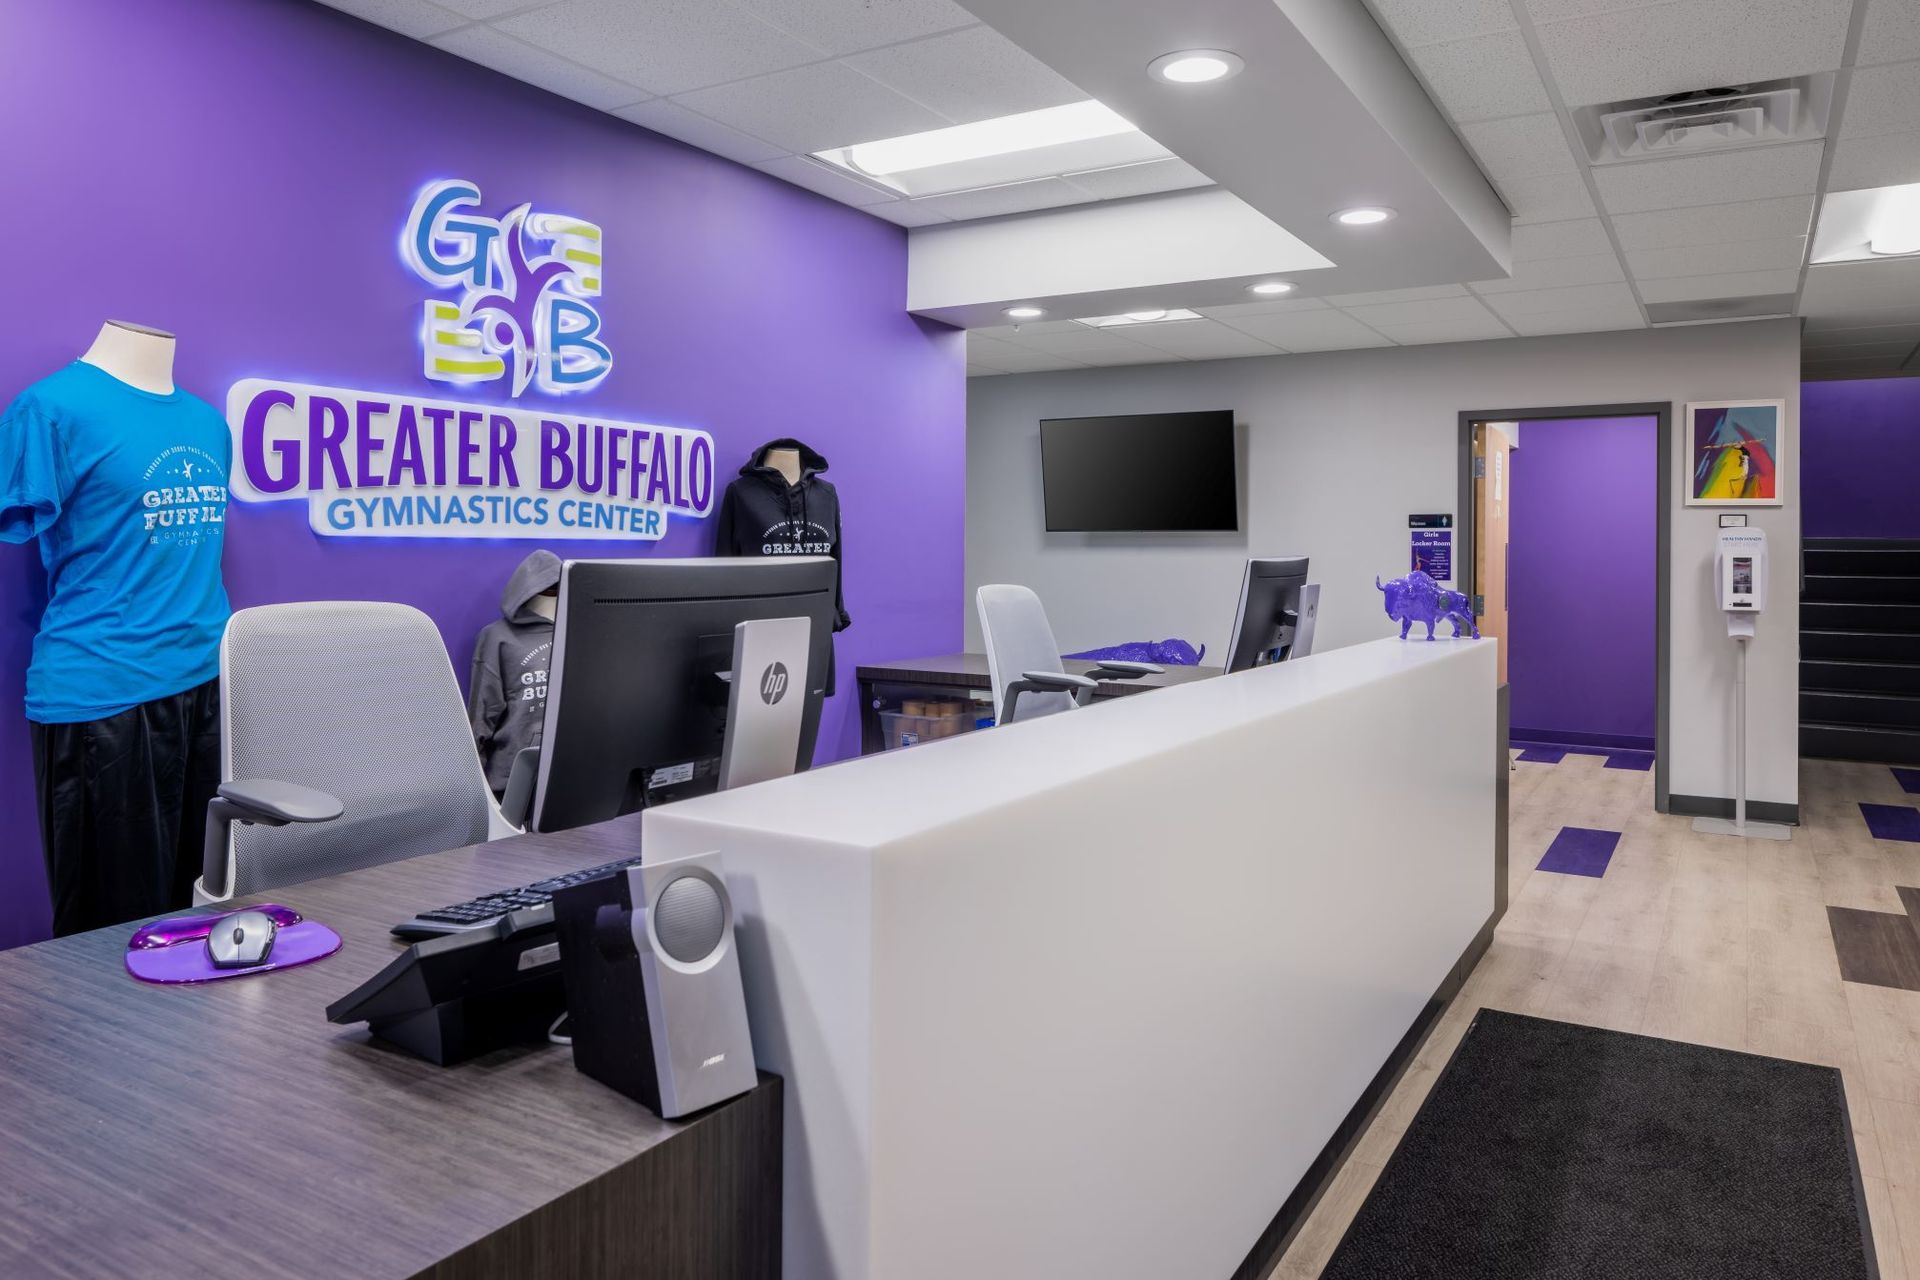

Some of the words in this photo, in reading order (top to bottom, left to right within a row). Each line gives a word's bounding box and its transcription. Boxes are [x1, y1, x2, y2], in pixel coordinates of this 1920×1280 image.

[241, 389, 520, 493] GREATER
[539, 419, 712, 512] BUFFALO
[327, 494, 549, 530] GYMNASTICS
[558, 498, 660, 535] CENTER
[521, 670, 549, 685] GR
[522, 685, 548, 700] BU
[761, 662, 788, 705] hp
